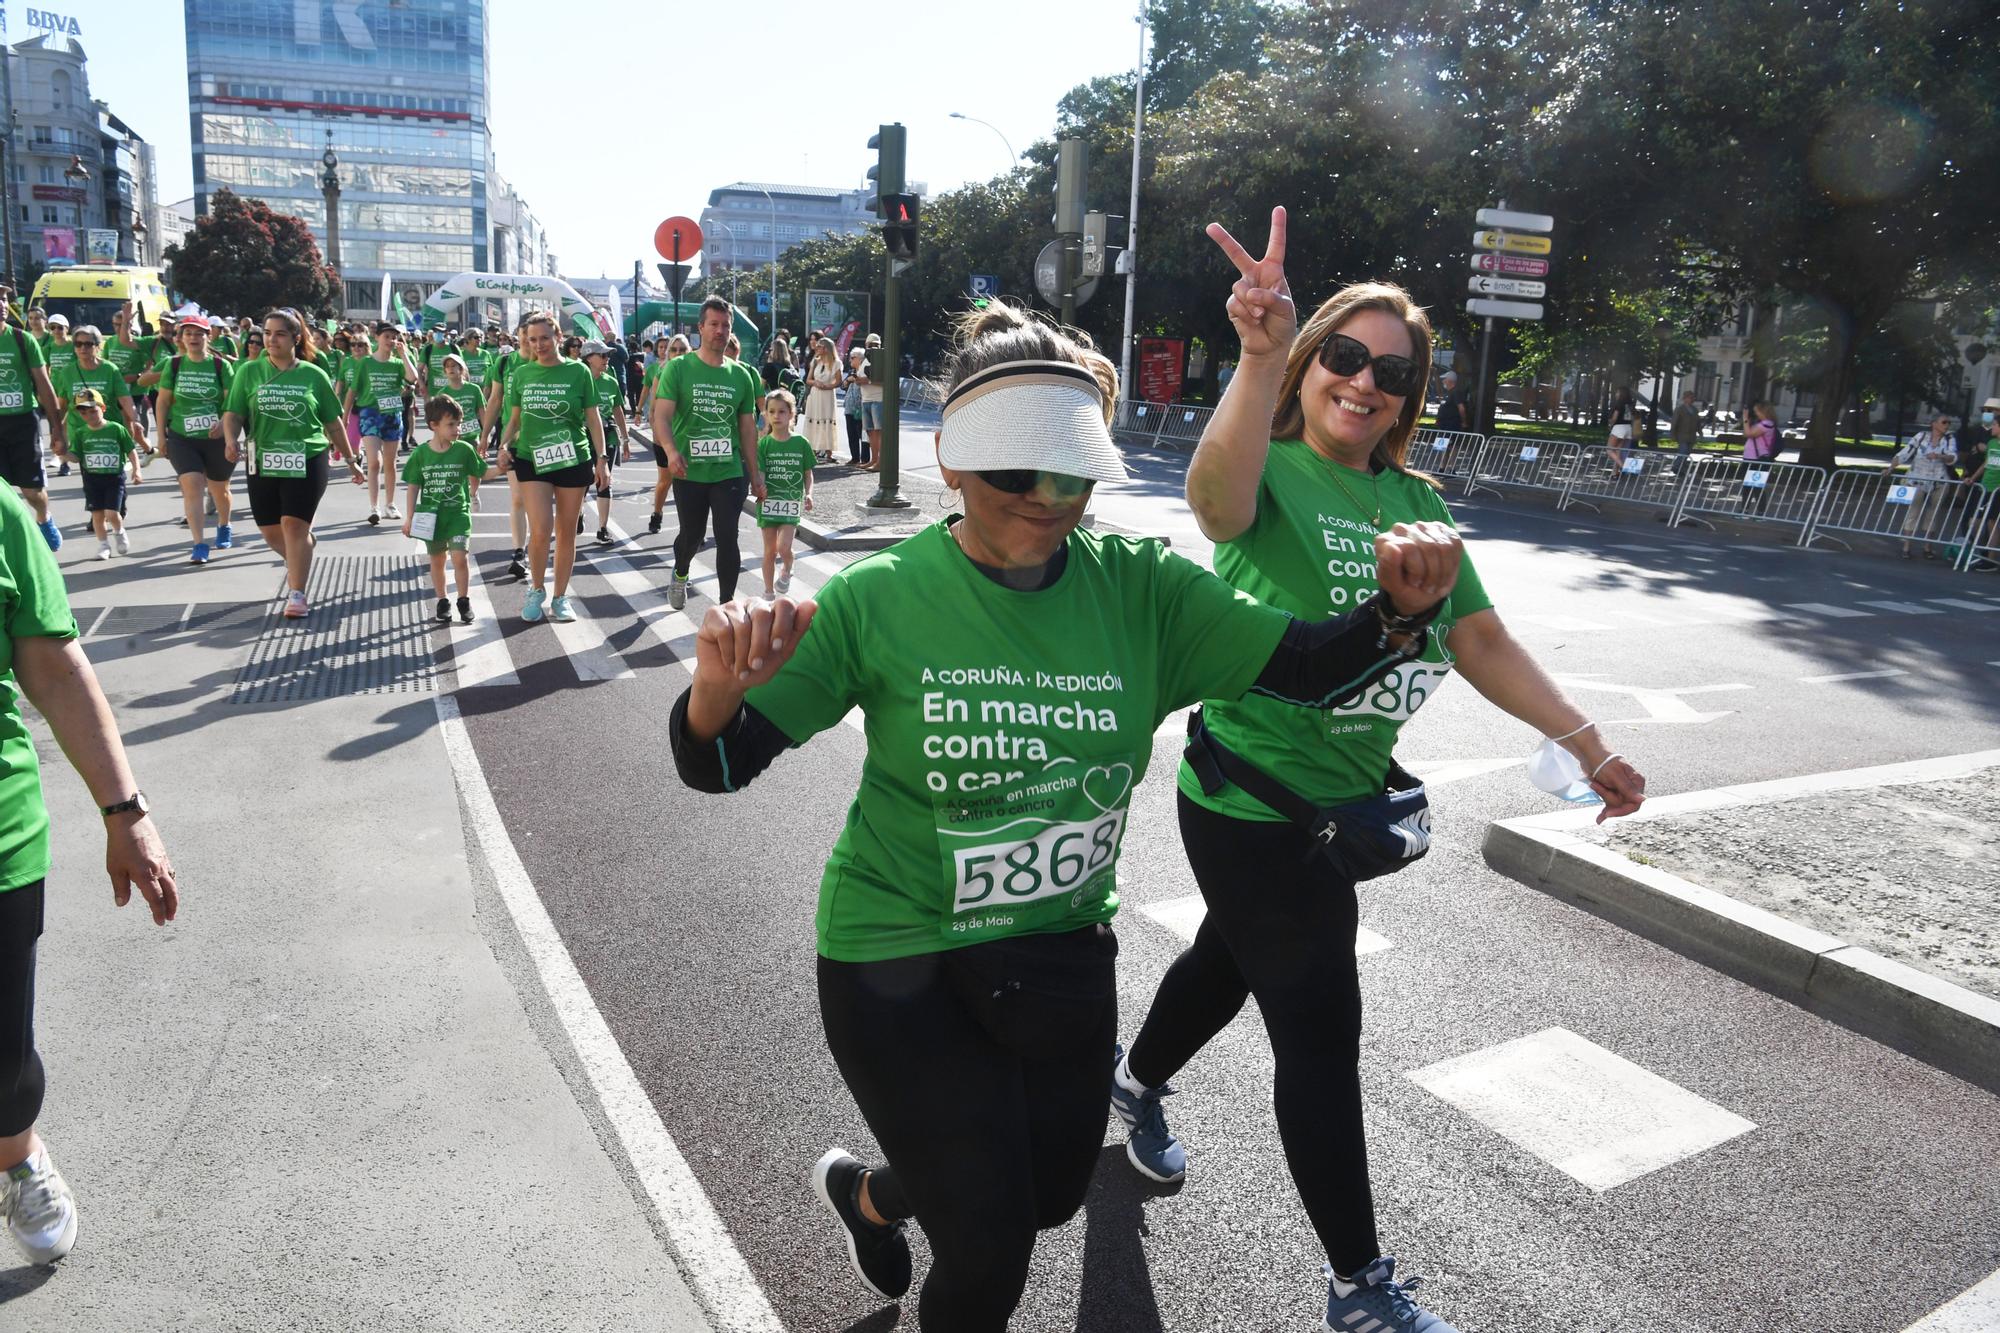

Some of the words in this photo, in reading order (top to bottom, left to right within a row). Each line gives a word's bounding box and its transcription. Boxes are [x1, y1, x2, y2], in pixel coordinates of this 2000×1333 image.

[27, 7, 82, 36] BBVA
[475, 279, 485, 289] El
[486, 280, 509, 290] Corte
[511, 279, 543, 294] Inglés
[974, 278, 987, 297] P
[814, 296, 831, 304] YES
[257, 395, 286, 404] contra
[269, 389, 304, 397] marcha
[533, 388, 566, 396] marcha
[692, 389, 704, 397] En
[705, 390, 733, 400] marcha
[535, 444, 575, 465] 5441
[691, 440, 731, 456] 5442
[86, 455, 119, 467] 5402
[263, 454, 305, 469] 5966
[763, 501, 799, 516] 5443
[1318, 513, 1327, 524] A
[1328, 516, 1380, 535] CORUÑA
[1322, 529, 1357, 553] En
[1330, 586, 1348, 605] o
[921, 667, 935, 685] A
[938, 665, 1025, 686] CORUÑA
[1036, 671, 1054, 688] IX
[1055, 671, 1123, 692] EDICIÓN
[923, 691, 968, 723] En
[980, 700, 1118, 732] marcha
[1342, 724, 1353, 733] de
[1354, 722, 1372, 733] Maio
[923, 729, 1048, 761] contra
[926, 770, 948, 792] o
[958, 794, 1005, 809] Coruña
[1006, 790, 1024, 802] en
[1026, 776, 1077, 797] marcha
[948, 807, 993, 824] contra
[996, 807, 1006, 817] o
[1008, 799, 1056, 817] cancro
[958, 819, 1118, 905] 5868
[968, 918, 983, 930] de
[985, 915, 1014, 928] Maio
